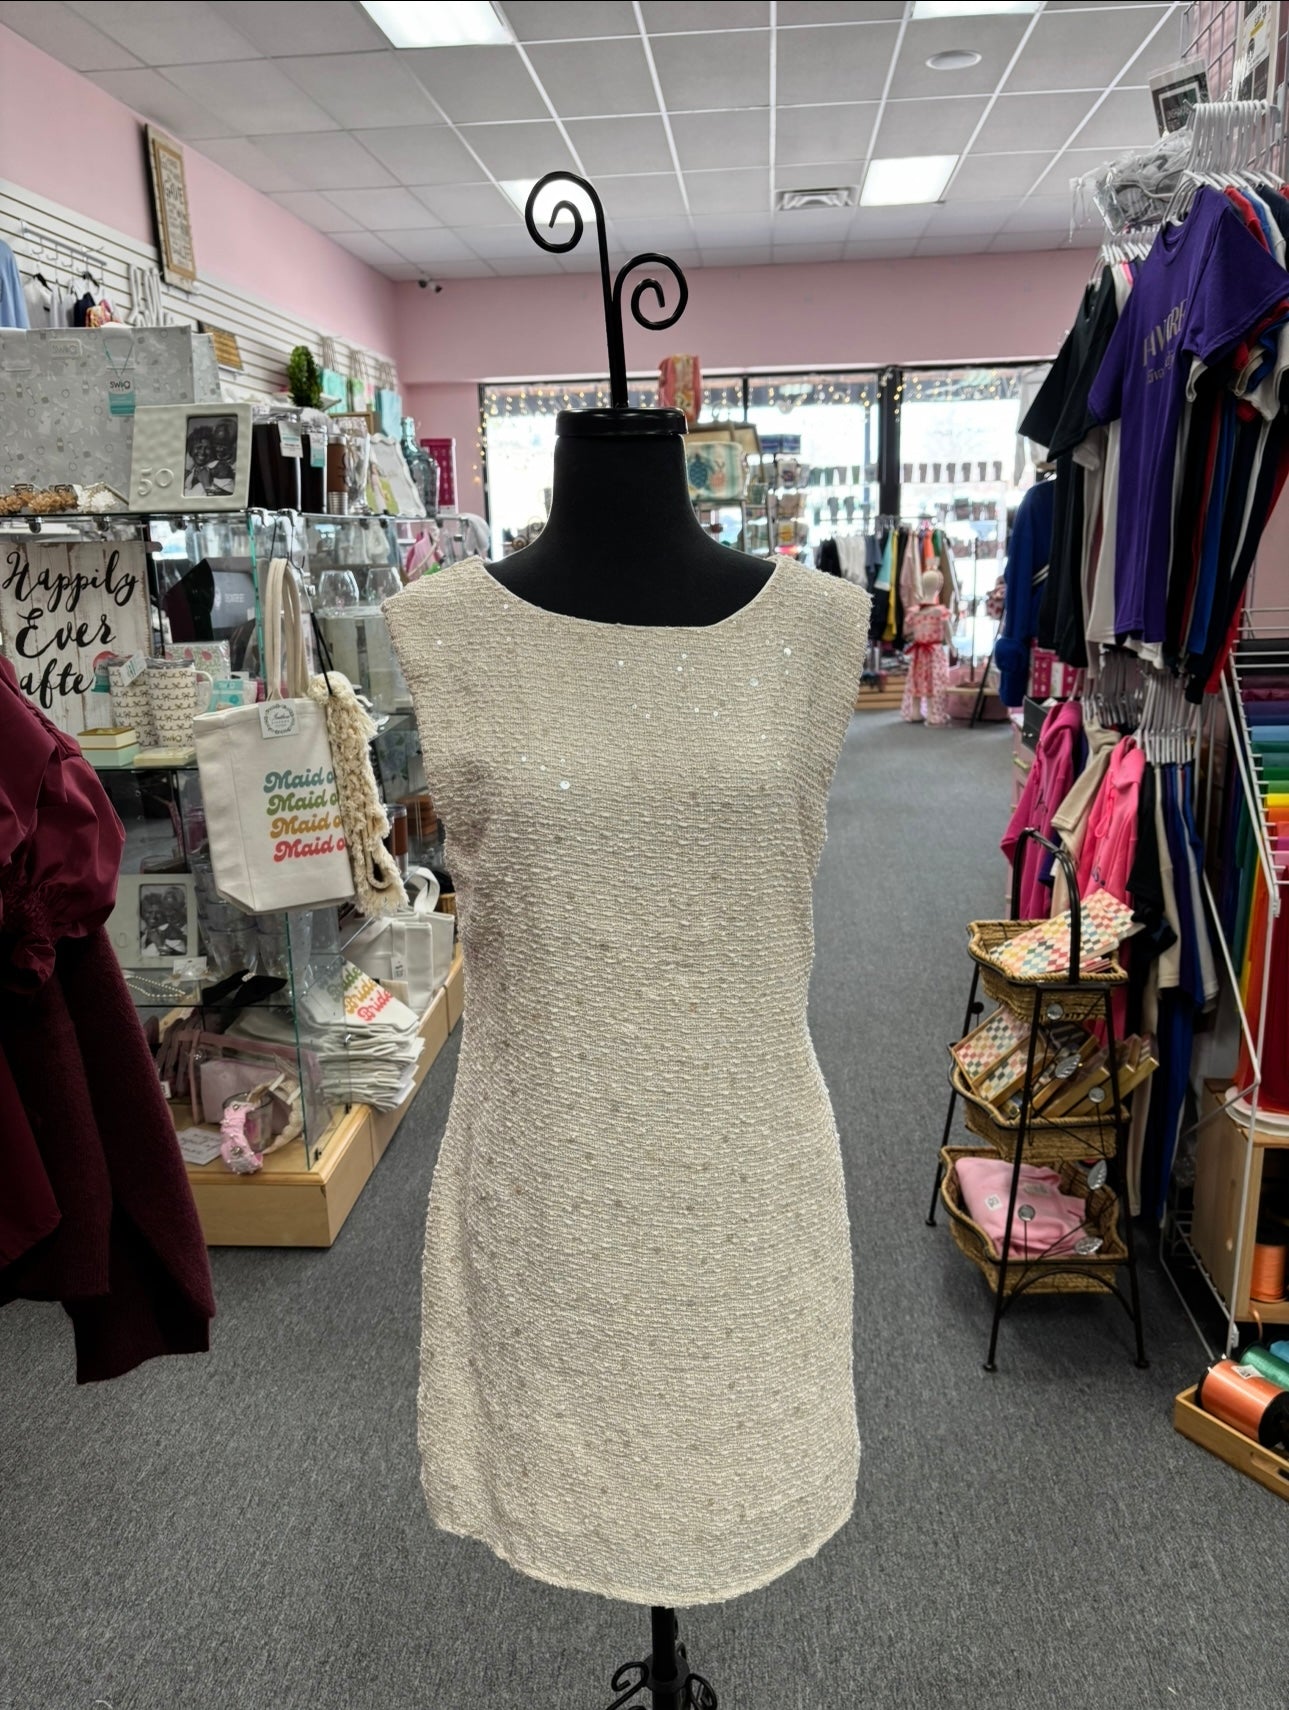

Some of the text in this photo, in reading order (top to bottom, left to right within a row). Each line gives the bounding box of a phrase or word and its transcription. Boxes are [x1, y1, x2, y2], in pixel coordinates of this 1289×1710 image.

[137, 466, 174, 498] 50
[2, 549, 139, 613] Happily
[15, 607, 117, 659] Ever
[263, 767, 324, 793] Maid
[266, 789, 328, 816] Maid
[270, 812, 331, 839] Maid
[273, 834, 334, 863] Maid
[357, 989, 393, 1022] Bride
